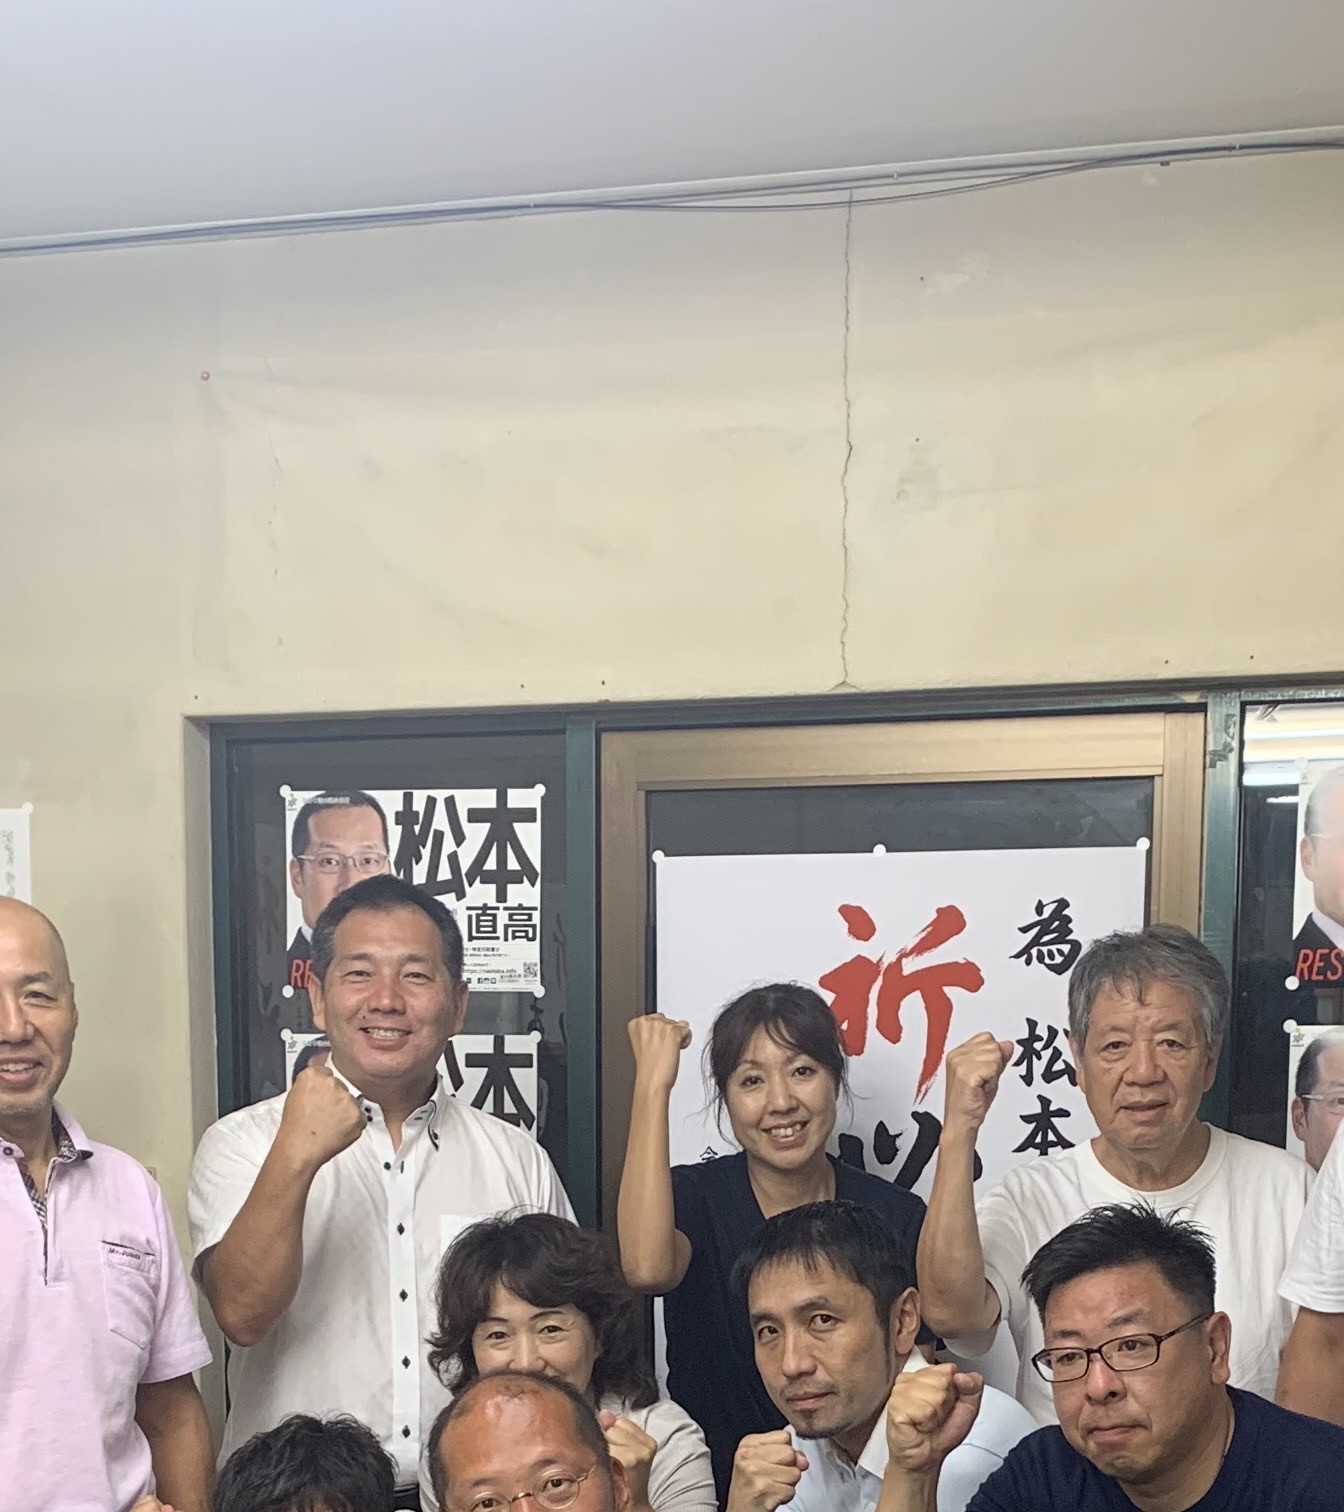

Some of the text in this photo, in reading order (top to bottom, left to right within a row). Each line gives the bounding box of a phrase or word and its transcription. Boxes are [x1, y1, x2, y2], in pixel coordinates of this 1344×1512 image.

[393, 788, 540, 904] 松本
[465, 902, 539, 943] 直高
[1008, 897, 1083, 1157] 為松本
